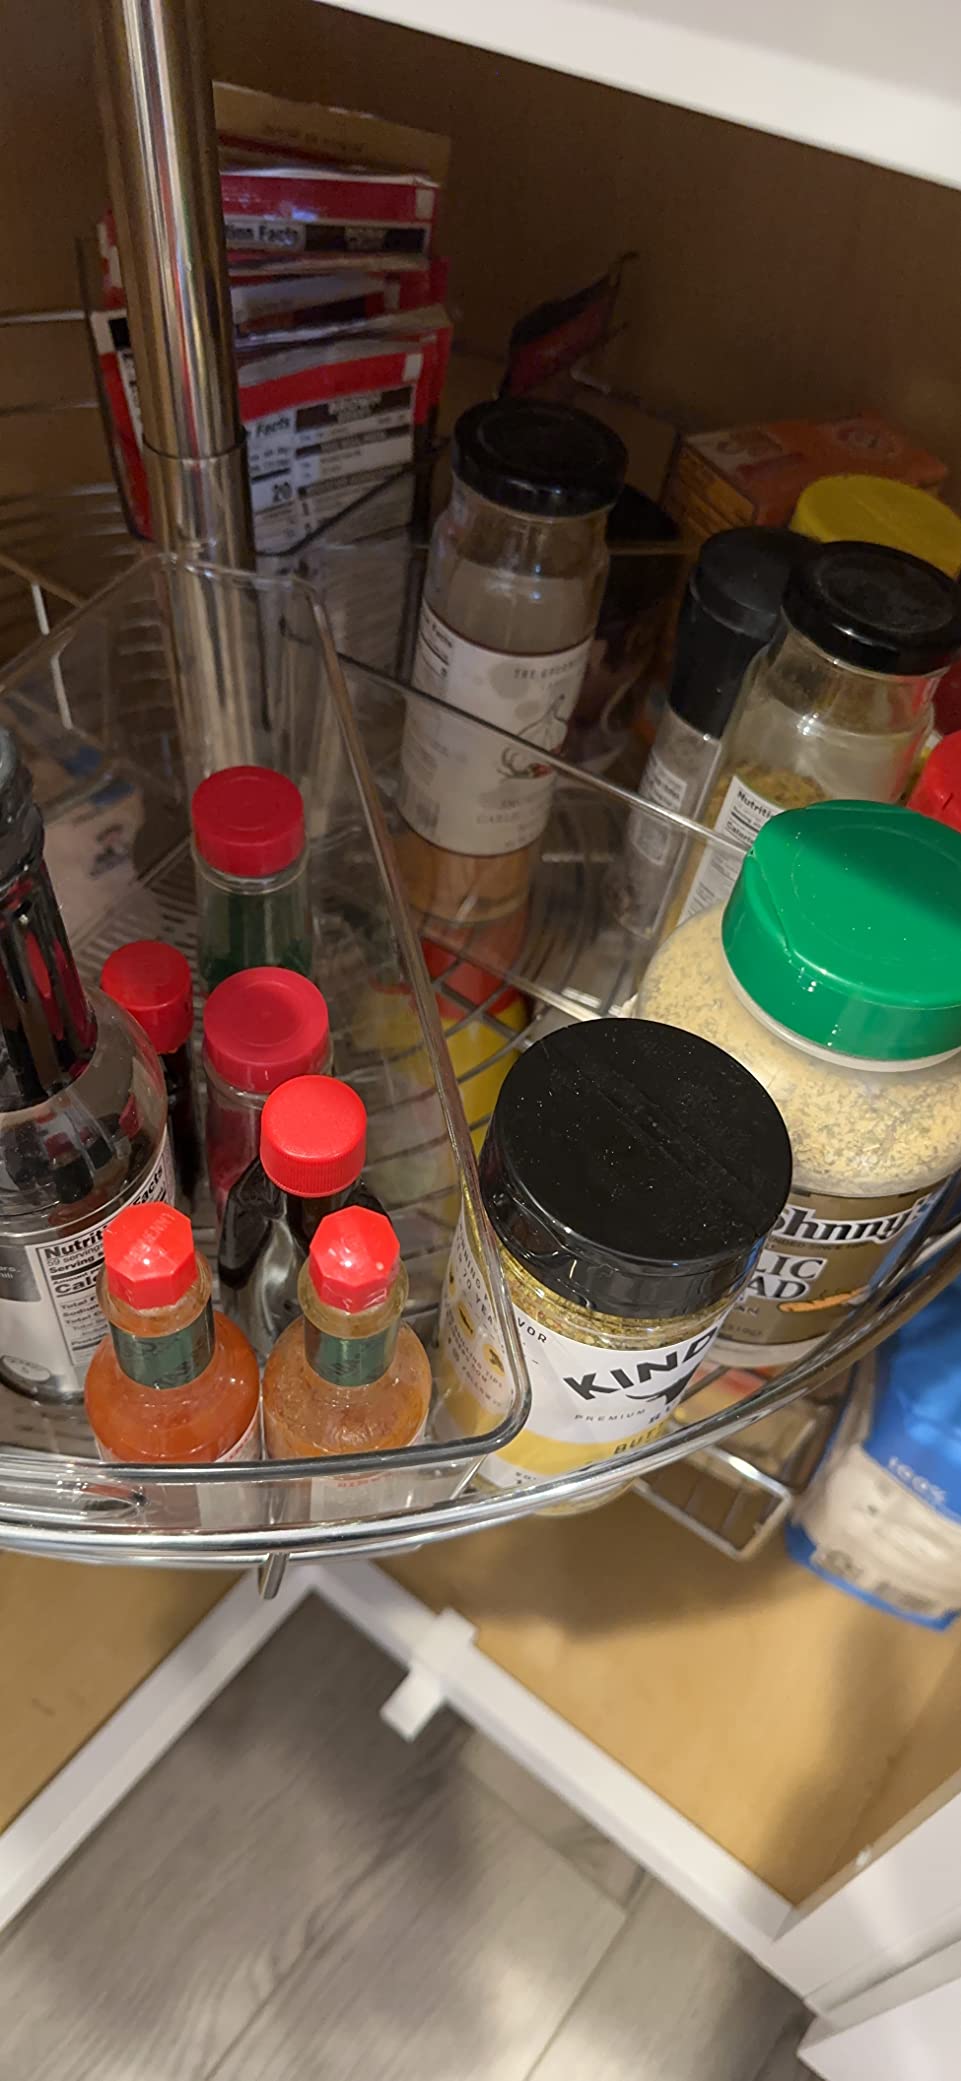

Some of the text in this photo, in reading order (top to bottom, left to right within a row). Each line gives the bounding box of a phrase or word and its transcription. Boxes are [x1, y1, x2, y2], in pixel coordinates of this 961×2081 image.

[258, 225, 298, 246] Facts
[256, 417, 290, 437] Facts
[45, 1225, 105, 1259] Nutrit
[63, 1244, 104, 1262] serving
[50, 1255, 95, 1273] Serving
[61, 1298, 88, 1310] Total
[574, 1408, 647, 1421] PREMIUM
